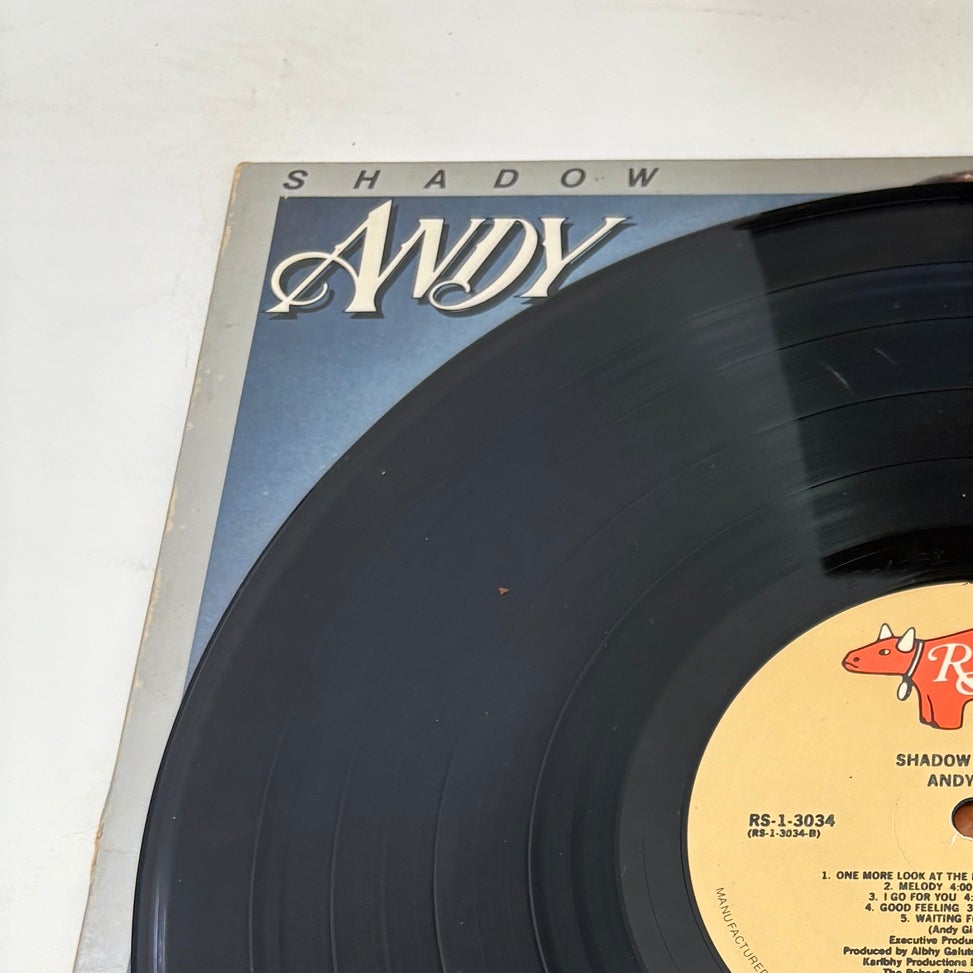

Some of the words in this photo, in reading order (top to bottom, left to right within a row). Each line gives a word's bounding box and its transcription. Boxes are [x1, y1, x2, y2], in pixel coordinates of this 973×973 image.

[283, 167, 660, 190] SHADOW
[263, 198, 632, 313] ANDY
[896, 754, 971, 767] SHADOW
[749, 813, 835, 827] RS-1-3034
[747, 829, 821, 839] (RS-1-3034-B)
[822, 871, 831, 880] 1.
[836, 871, 859, 880] ONE
[862, 871, 893, 880] MORE
[897, 871, 925, 880] LOOK
[929, 872, 943, 880] AT
[946, 872, 968, 880] THE
[883, 882, 893, 890] 2.
[899, 882, 943, 891] MELODY
[949, 883, 973, 891] 4:00
[868, 892, 878, 901] 3.
[884, 893, 887, 901] I
[890, 893, 907, 901] GO
[910, 893, 931, 901] FOR
[935, 893, 957, 901] YOU
[865, 903, 874, 912] 4.
[880, 903, 911, 912] GOOD
[915, 904, 959, 912] FEELING
[900, 914, 910, 922] 5.
[916, 914, 962, 923] WAITING
[928, 925, 958, 935] (Andy
[889, 936, 938, 944] Executive
[843, 947, 892, 955] Produced
[896, 947, 907, 957] by
[911, 947, 940, 957] Albhy
[863, 957, 902, 968] Karlbhy
[906, 958, 967, 967] Productions
